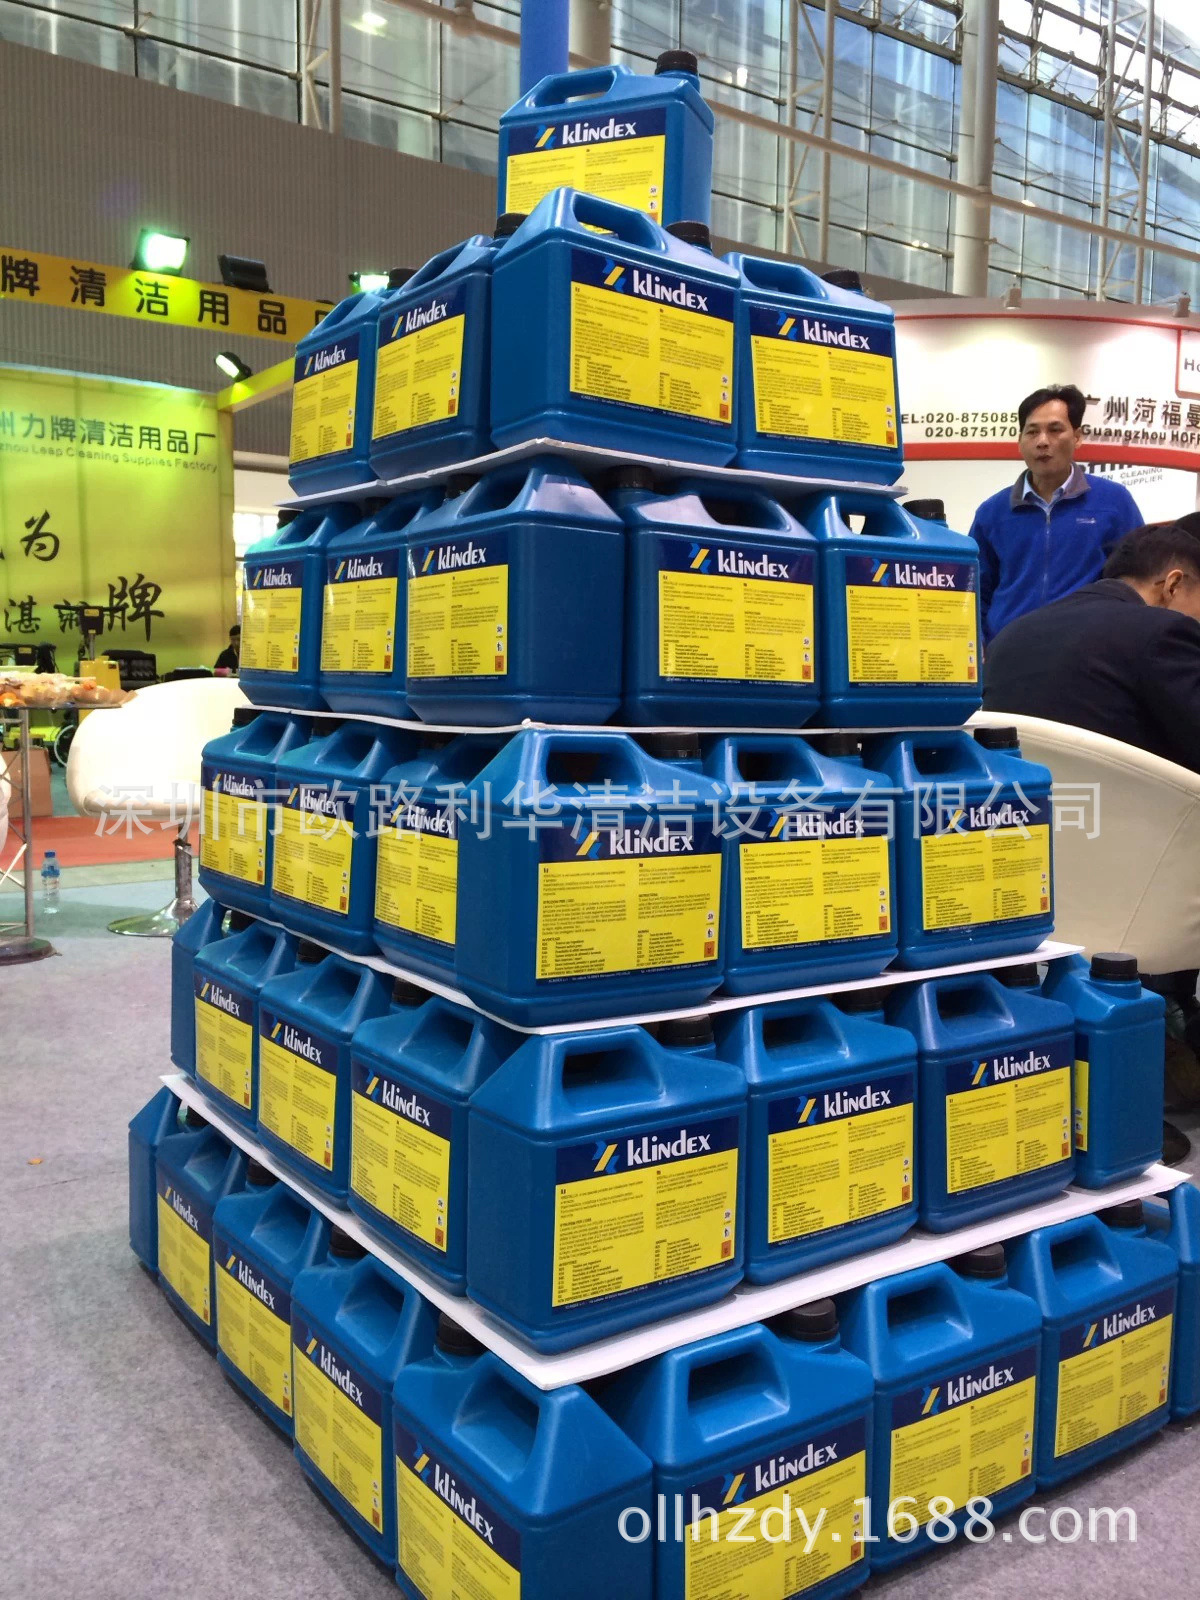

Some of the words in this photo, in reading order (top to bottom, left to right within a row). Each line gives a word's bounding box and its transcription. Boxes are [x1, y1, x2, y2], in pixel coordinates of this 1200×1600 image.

[1, 254, 336, 336] 牌清洁用品
[1081, 424, 1167, 441] Guangzhou
[122, 453, 172, 467] Supplies
[175, 458, 217, 473] Factory
